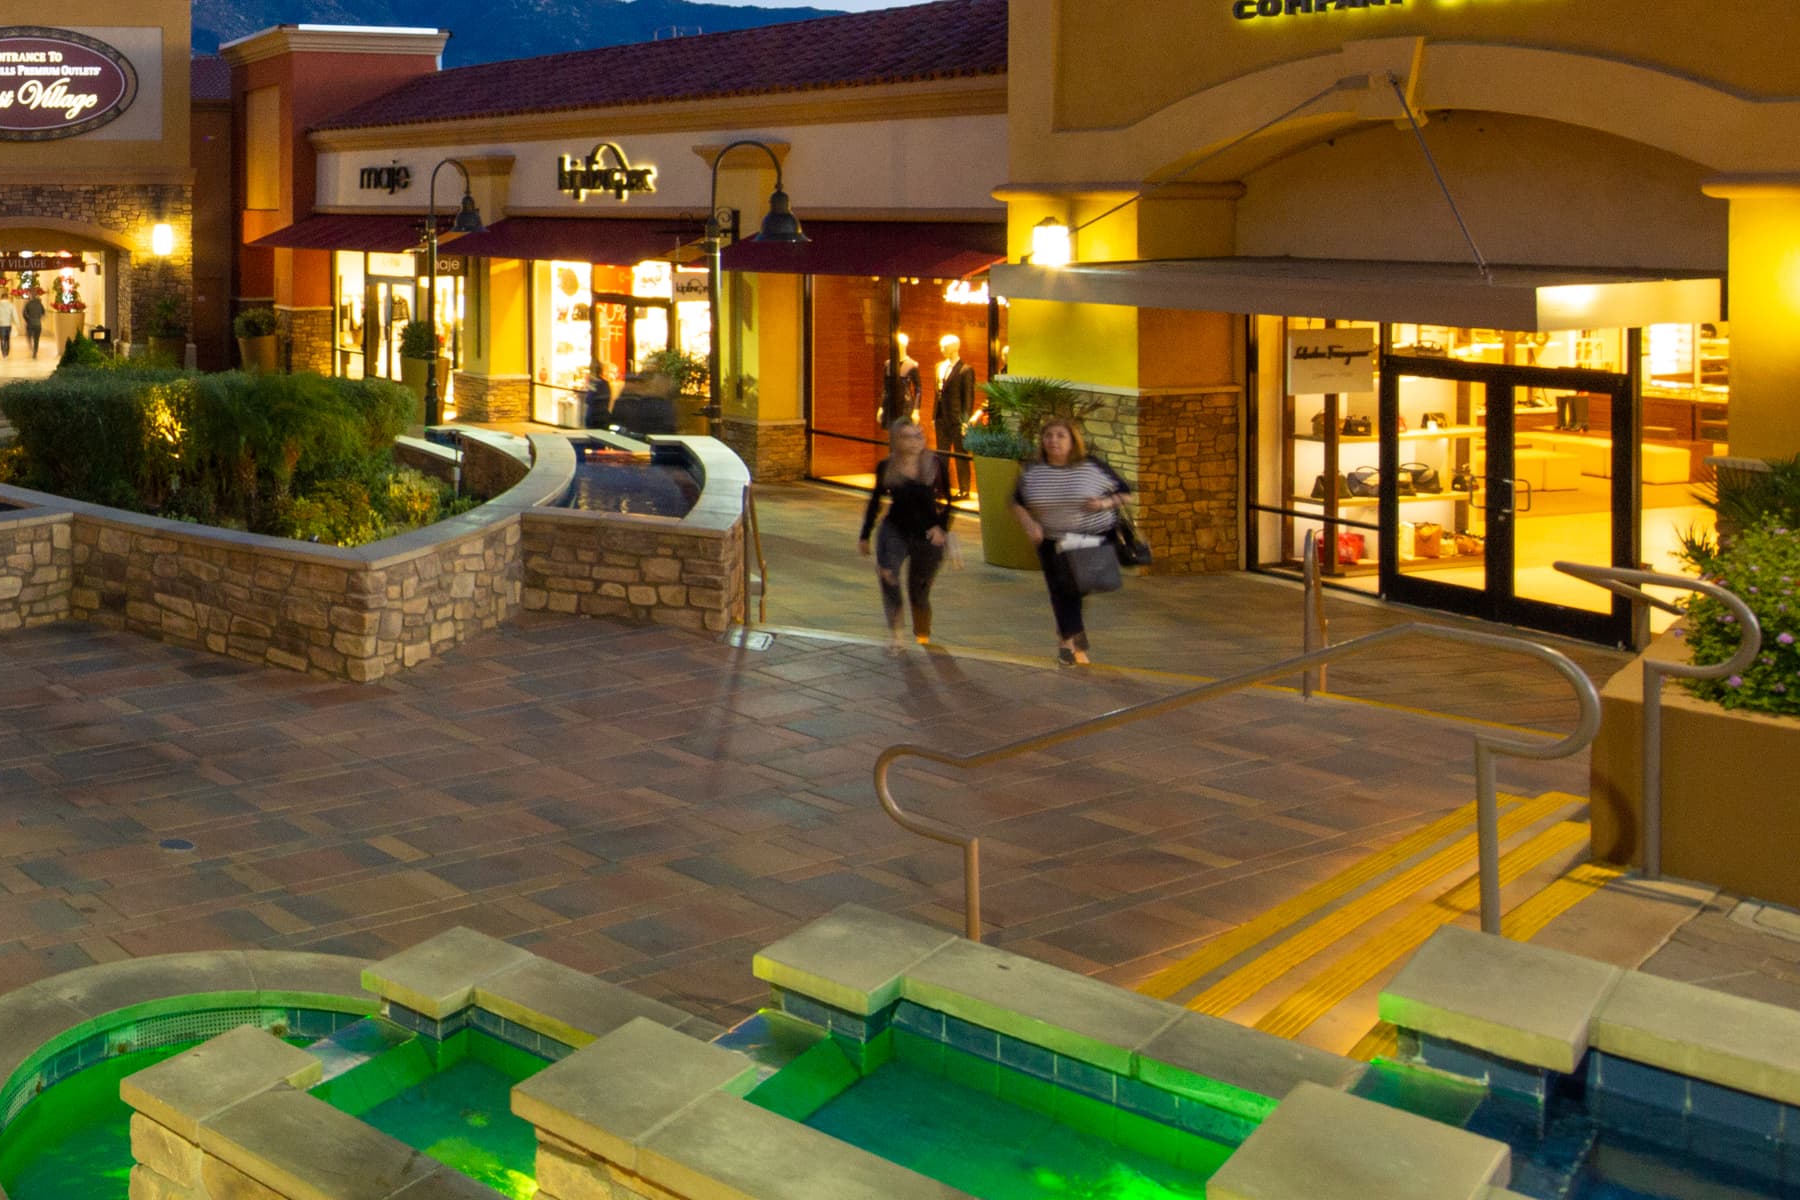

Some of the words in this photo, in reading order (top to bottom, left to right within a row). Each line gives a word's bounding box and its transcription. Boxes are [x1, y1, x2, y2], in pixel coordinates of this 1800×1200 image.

[17, 77, 98, 120] Village
[359, 159, 412, 195] maje
[8, 259, 46, 269] VILLAGE
